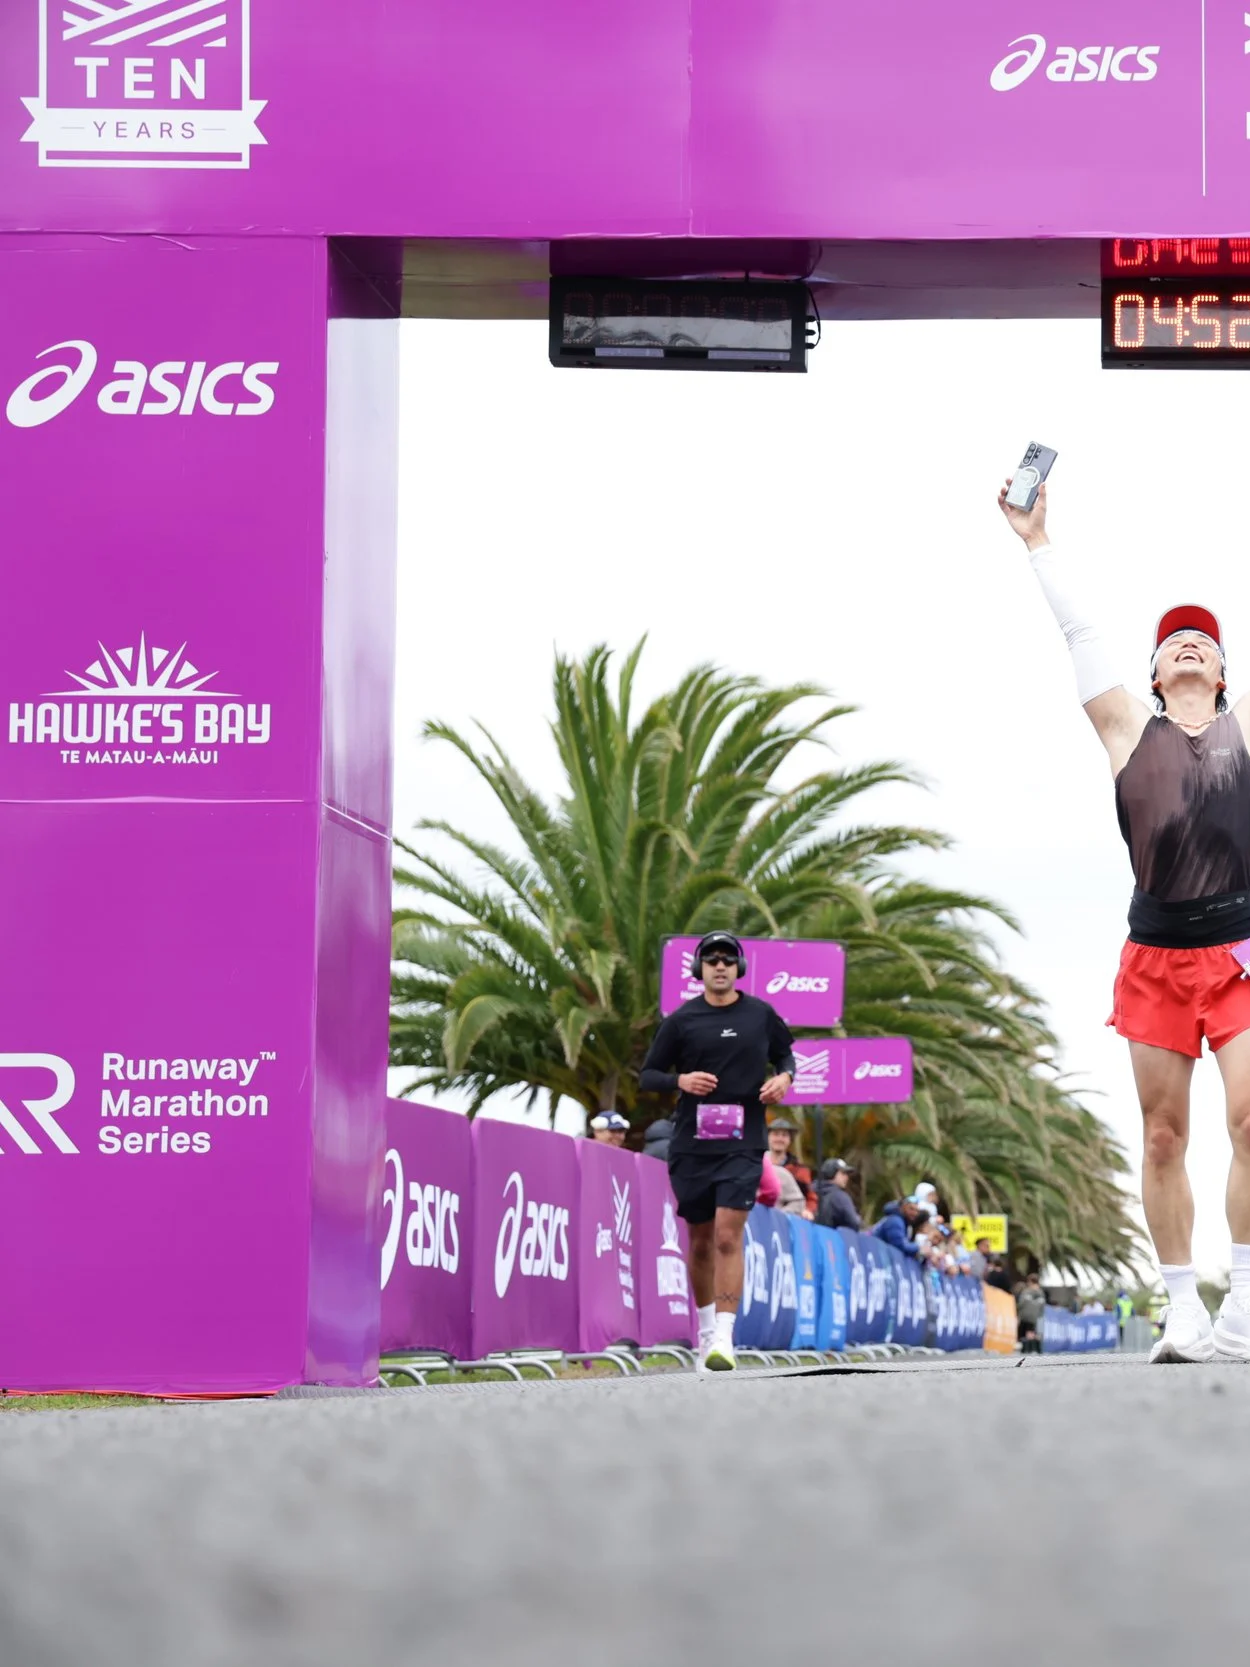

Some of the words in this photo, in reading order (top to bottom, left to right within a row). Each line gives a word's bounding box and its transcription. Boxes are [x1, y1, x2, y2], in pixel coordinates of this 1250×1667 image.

[74, 57, 205, 99] TEN
[1046, 46, 1160, 82] asics
[92, 120, 196, 140] YEARS
[97, 361, 280, 416] asics
[9, 703, 184, 744] HAWKE'S
[194, 703, 271, 744] BAY
[60, 750, 80, 764] TE
[85, 748, 218, 764] MATAU-A-MĀUI
[100, 1089, 269, 1117] Marathon
[98, 1126, 211, 1154] Series
[406, 1182, 460, 1274] asics
[520, 1201, 569, 1281] asics
